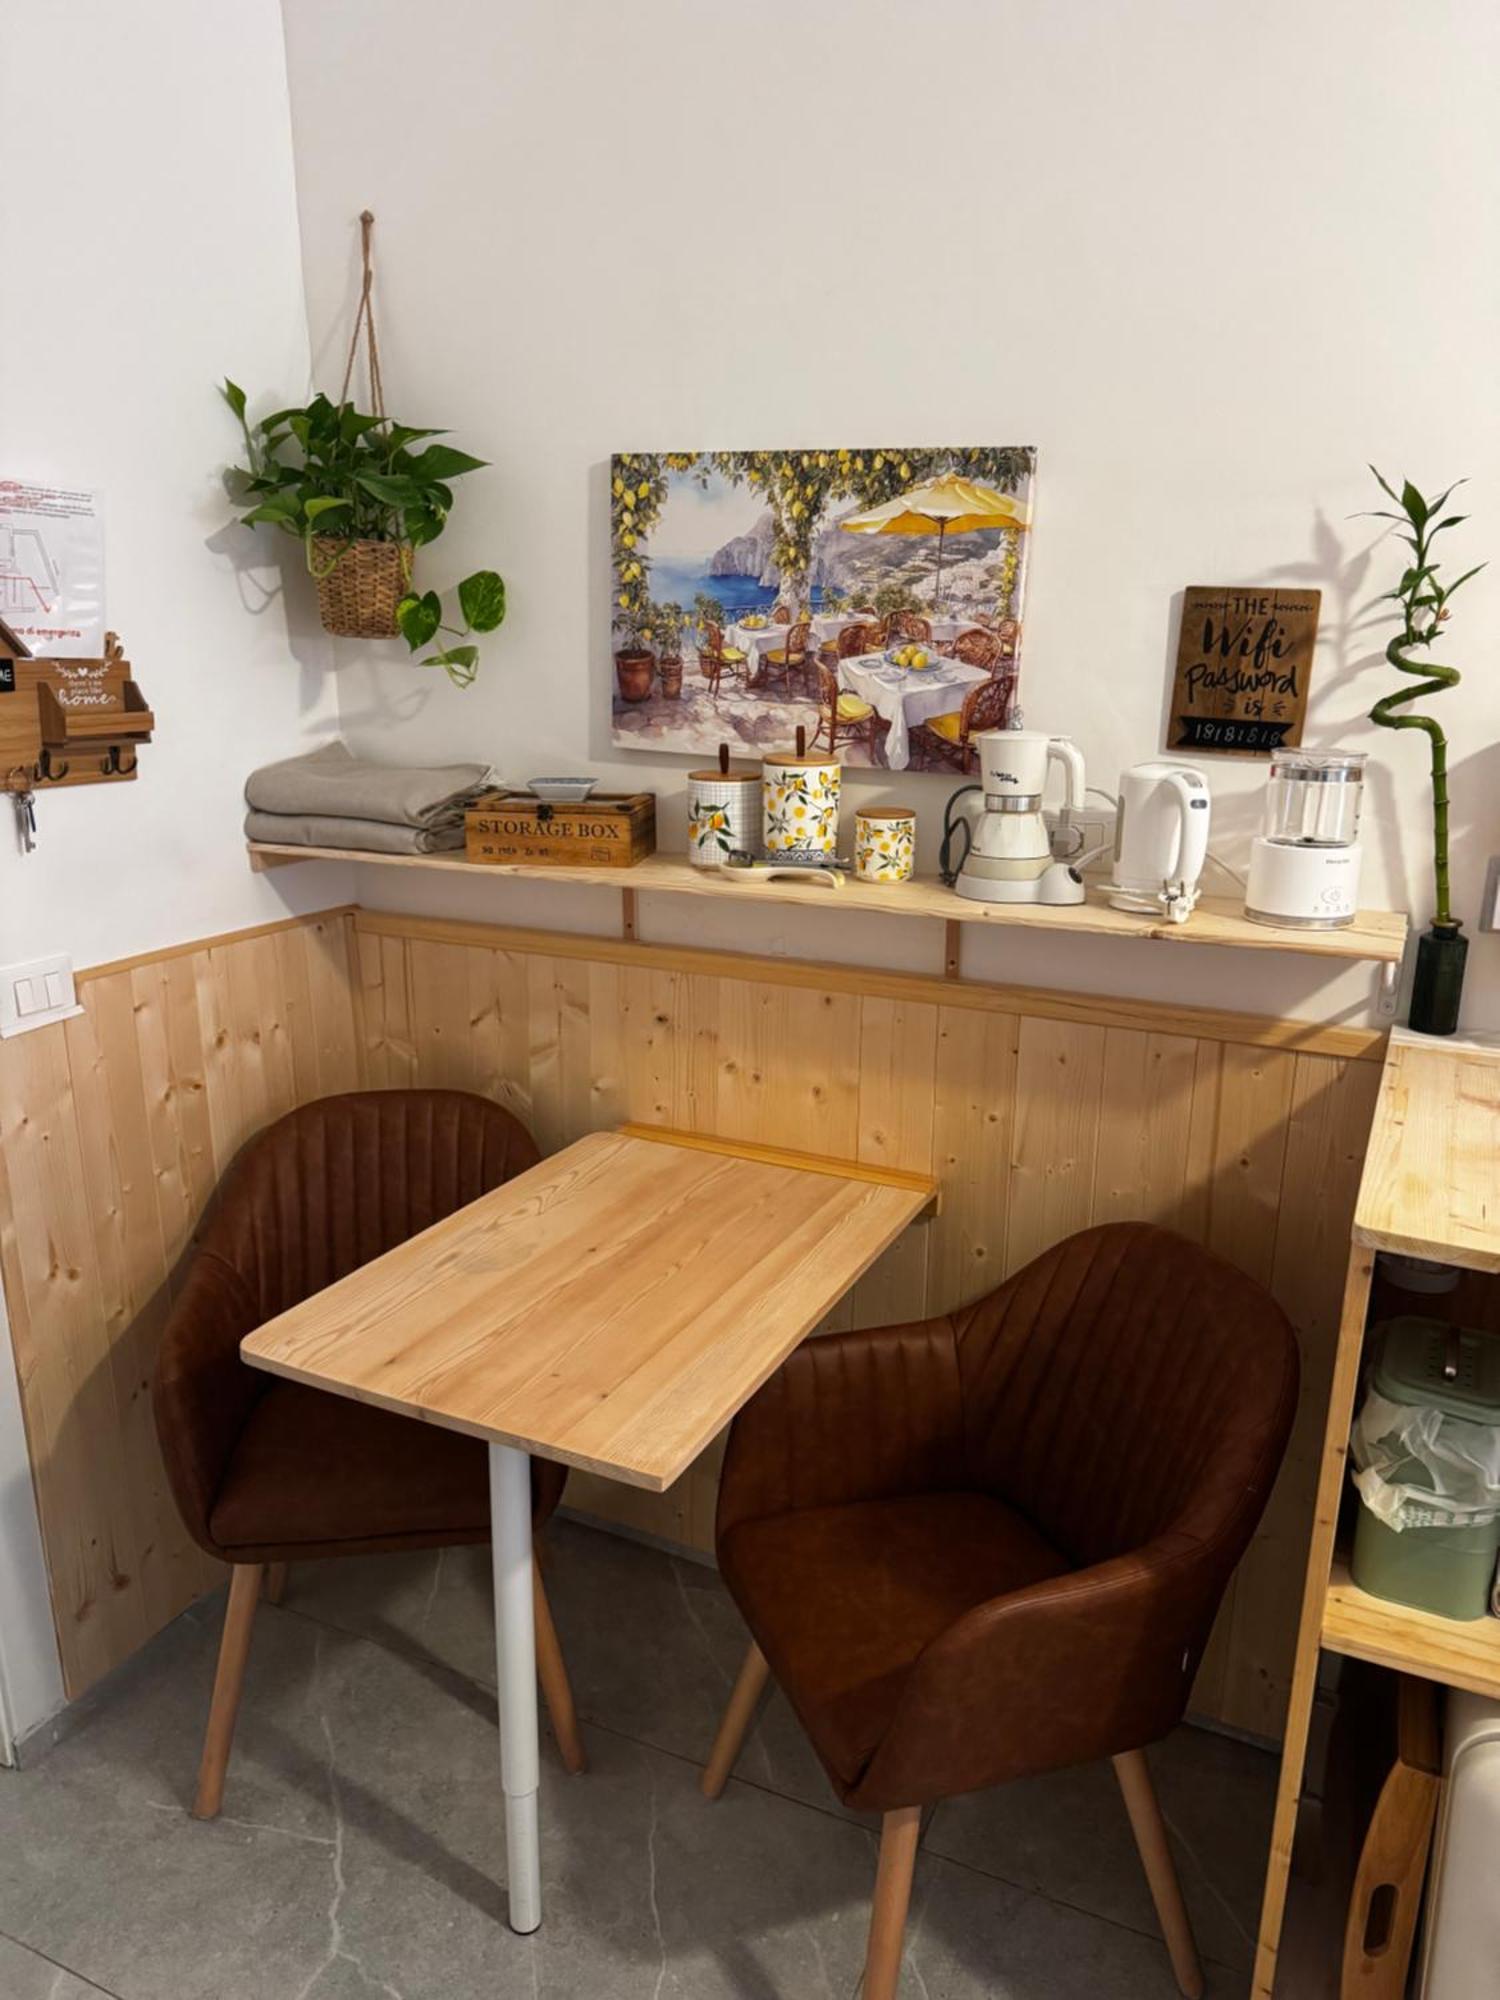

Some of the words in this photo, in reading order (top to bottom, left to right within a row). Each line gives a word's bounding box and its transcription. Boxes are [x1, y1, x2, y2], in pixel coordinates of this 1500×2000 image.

[1233, 597, 1270, 615] THE
[1203, 617, 1296, 669] Wifi
[1184, 663, 1298, 704] Password
[59, 688, 117, 706] home
[1244, 697, 1263, 716] is
[478, 819, 574, 837] STORAGE
[577, 823, 619, 839] BOX
